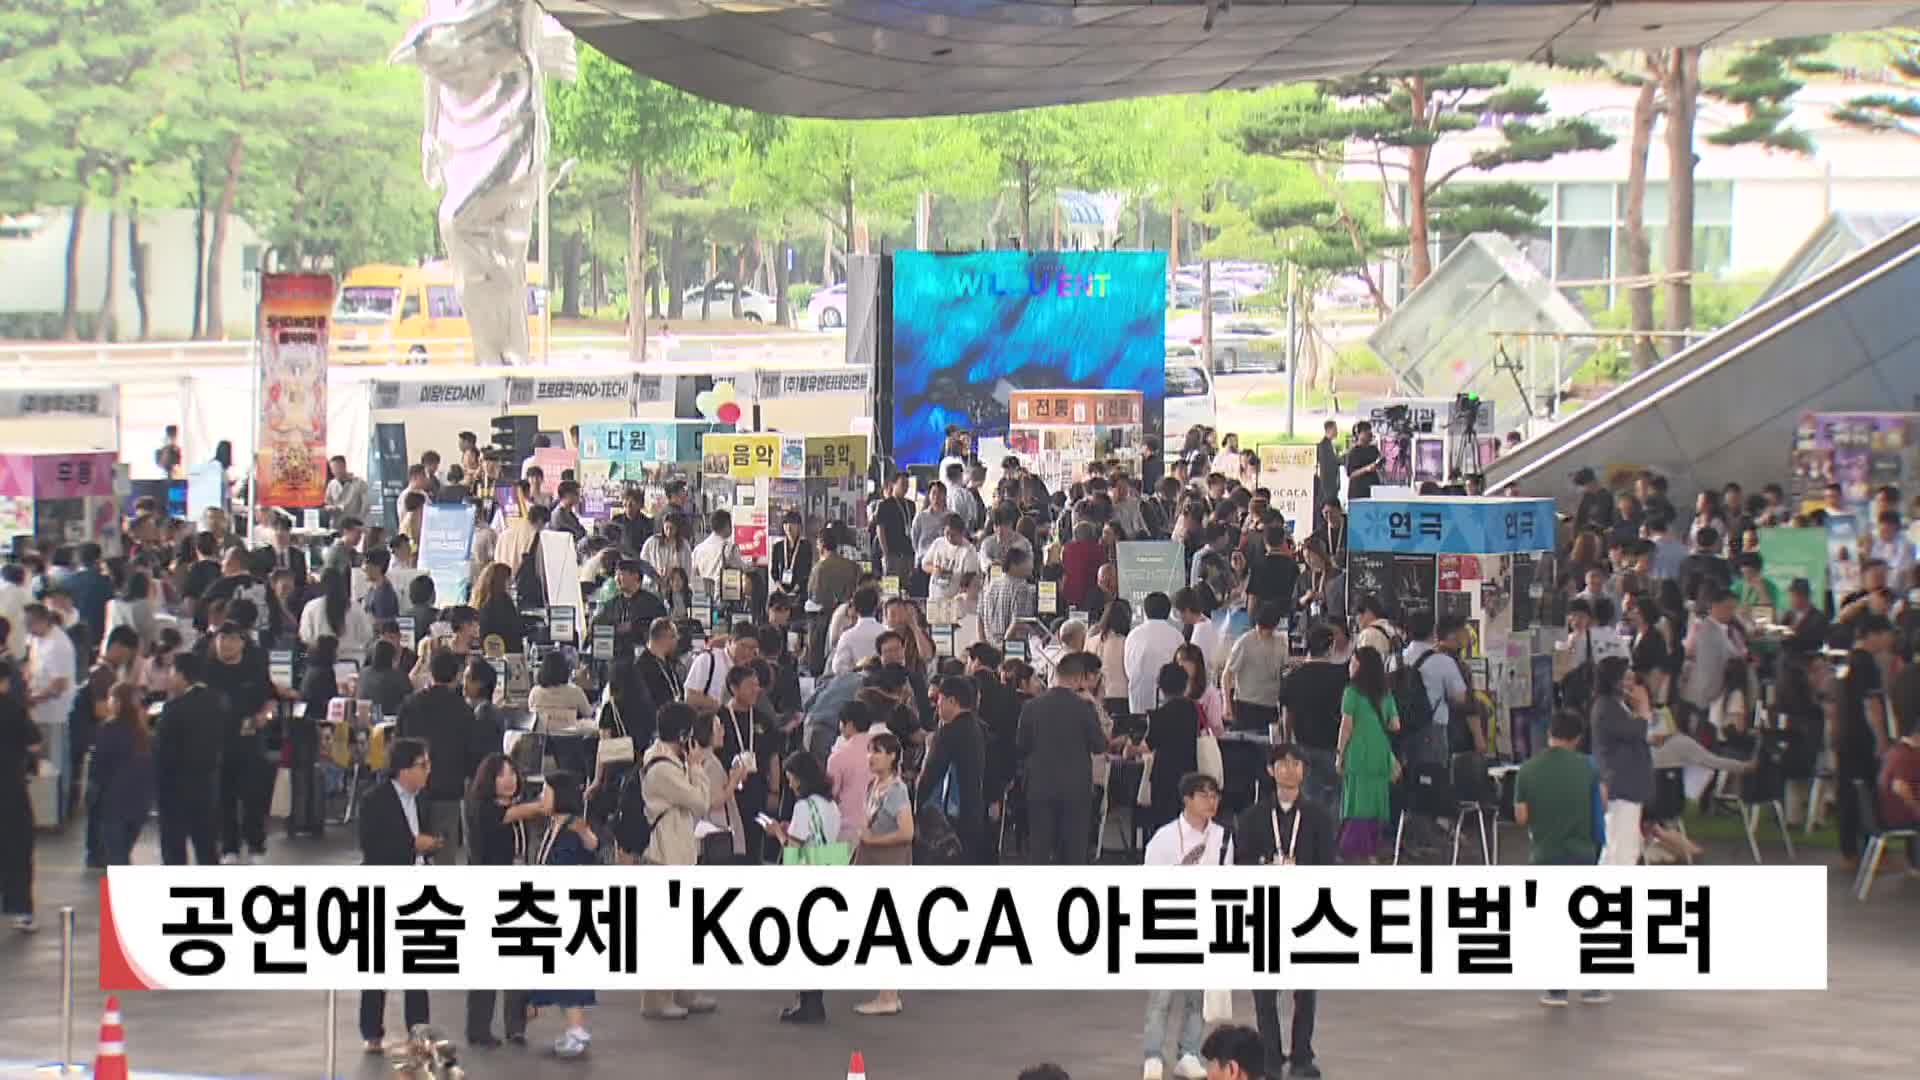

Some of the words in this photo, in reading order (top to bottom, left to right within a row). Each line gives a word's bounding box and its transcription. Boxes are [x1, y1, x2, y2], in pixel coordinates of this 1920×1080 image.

[1057, 274, 1112, 298] ENT
[607, 429, 646, 452] 다원
[732, 443, 774, 468] 음악
[823, 443, 850, 467] 음악
[1388, 511, 1443, 541] 연극
[1504, 510, 1534, 540] 연극
